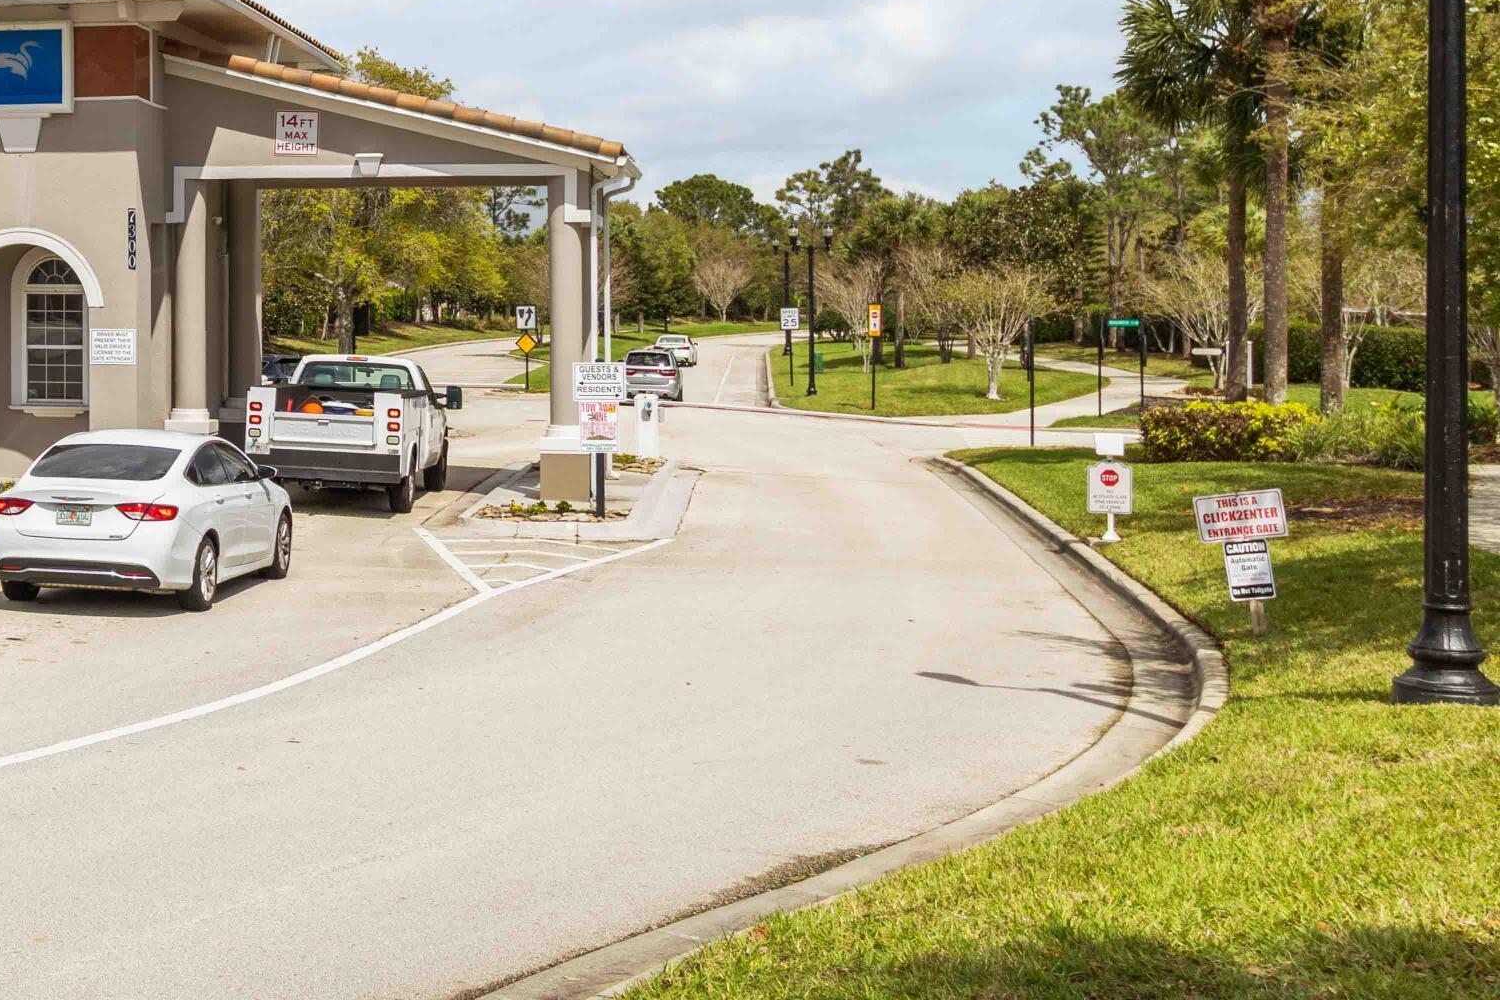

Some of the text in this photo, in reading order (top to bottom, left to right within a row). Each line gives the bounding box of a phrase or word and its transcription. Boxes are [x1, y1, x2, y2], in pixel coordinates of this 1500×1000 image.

[284, 131, 308, 140] MAX
[277, 142, 316, 151] HEIGHT
[128, 209, 136, 268] 7300
[783, 318, 797, 327] 25
[579, 365, 611, 373] GUESTS
[581, 373, 617, 381] VENDORS
[581, 403, 617, 413] TOW AWAY
[1101, 474, 1118, 482] STOP
[1216, 496, 1257, 508] THIS IS A
[1203, 507, 1278, 524] CLICK2ENTER
[1207, 523, 1279, 538] ENTRANCE GATE
[1226, 541, 1266, 554] CAUTION
[1231, 556, 1266, 564] Automatic
